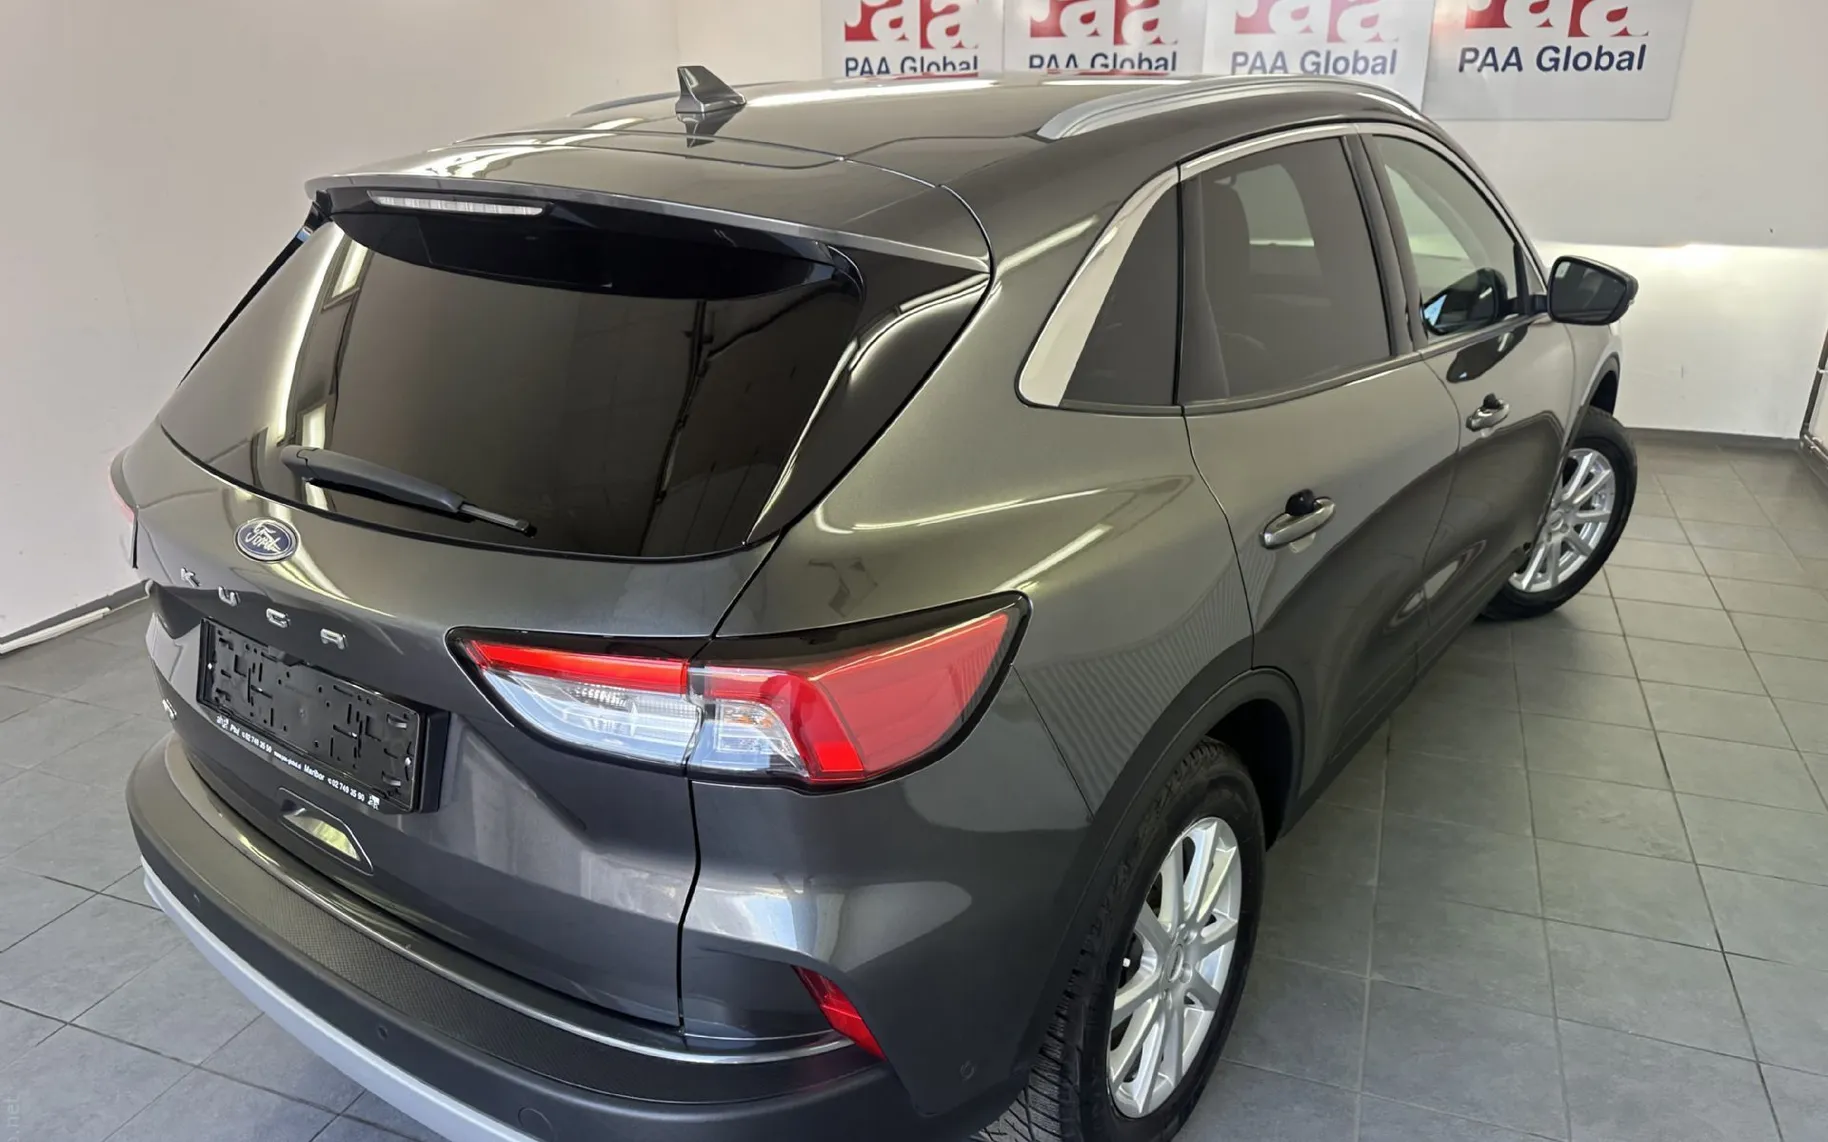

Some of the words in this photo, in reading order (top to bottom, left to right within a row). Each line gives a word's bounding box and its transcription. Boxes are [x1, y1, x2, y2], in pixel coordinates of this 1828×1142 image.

[845, 56, 891, 77] PAA
[900, 55, 978, 75] Global
[1029, 53, 1078, 70] PAA
[1090, 50, 1177, 71] Global
[1231, 50, 1289, 76] PAA
[1300, 49, 1398, 76] Global
[1458, 46, 1523, 73] PAA
[1536, 44, 1647, 73] Global
